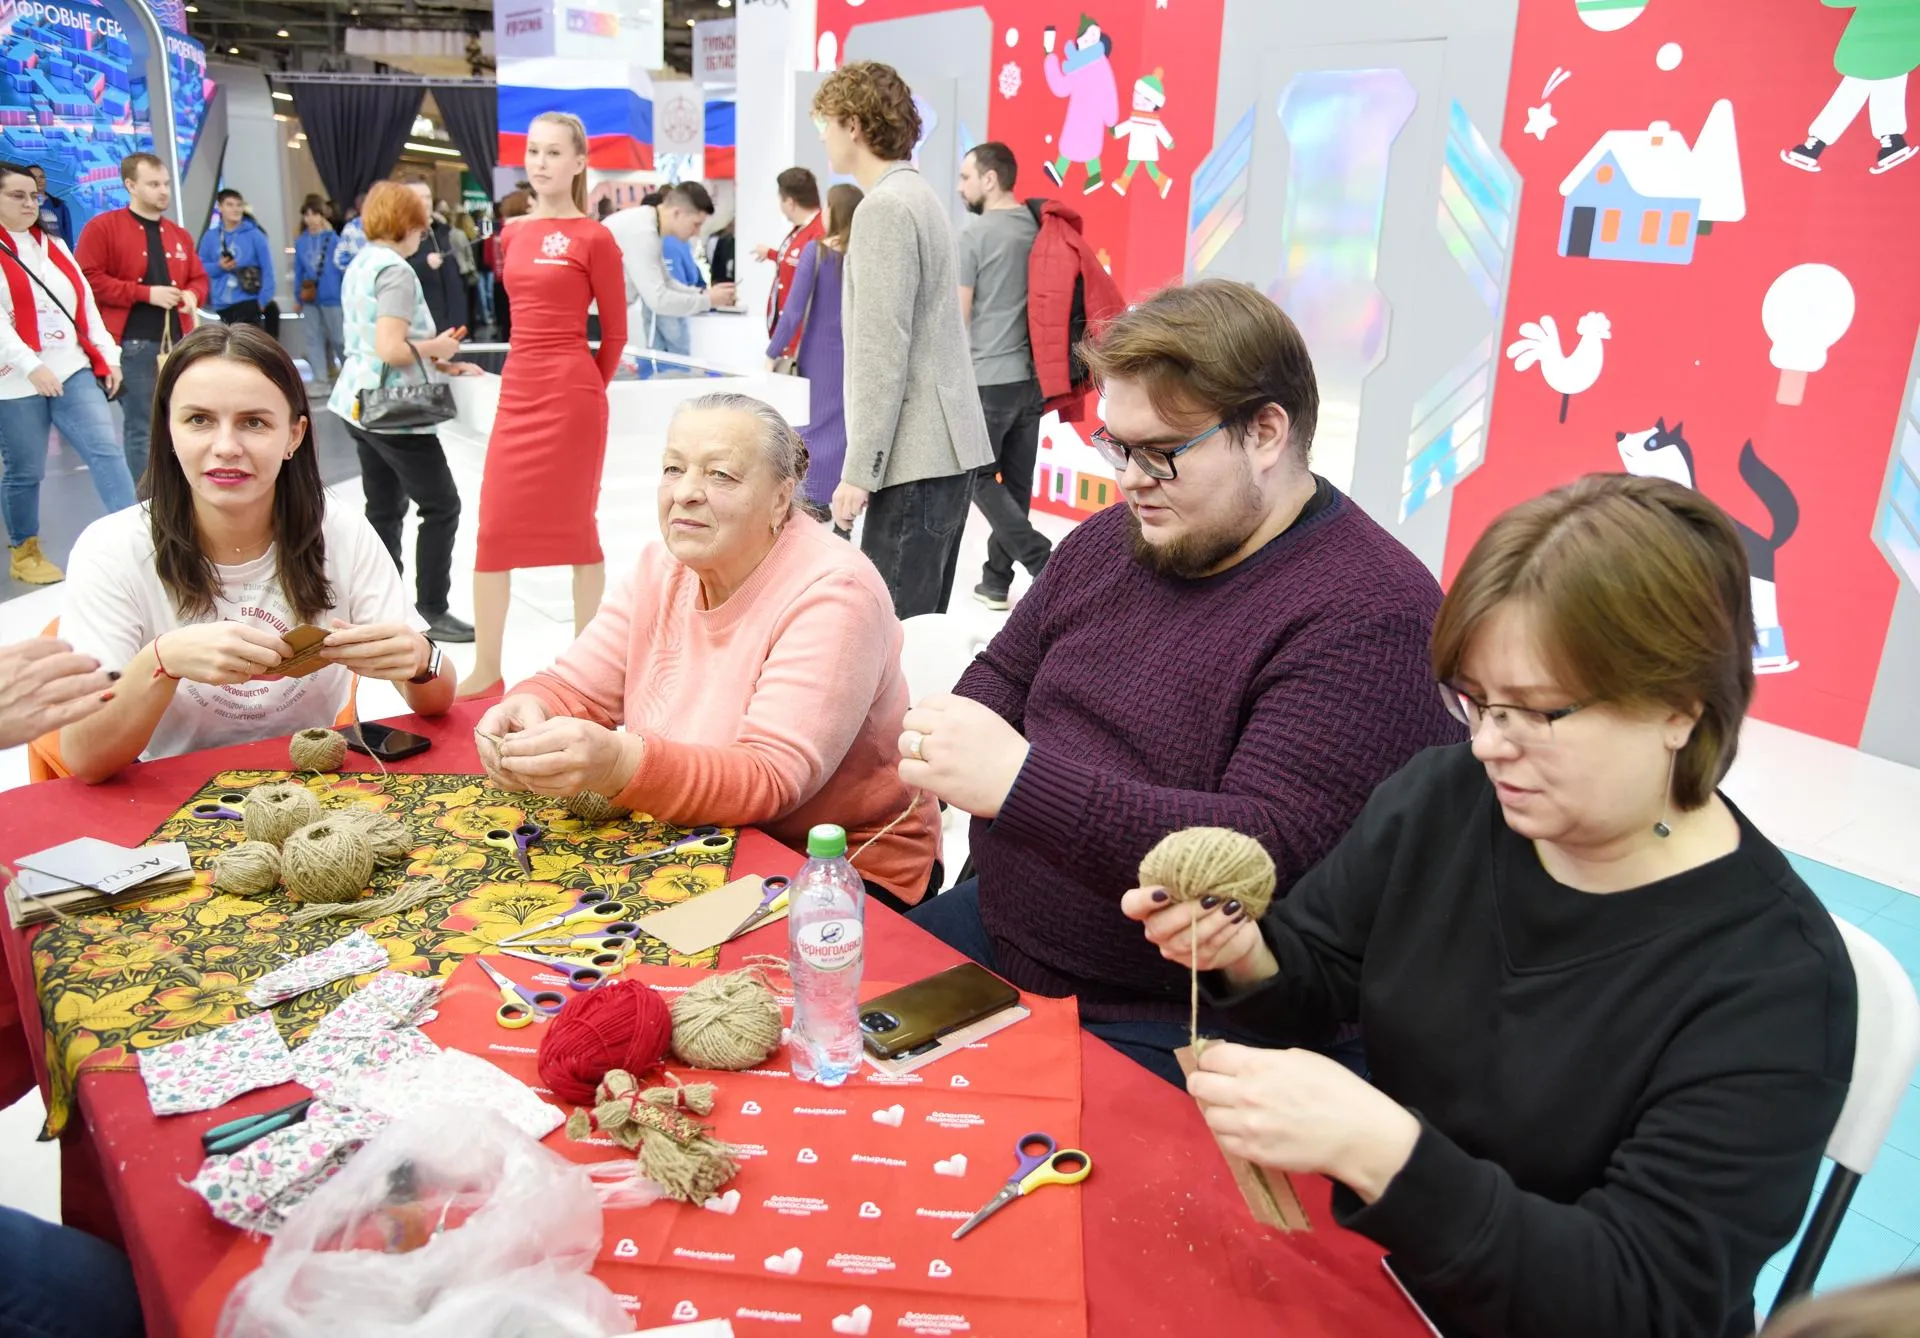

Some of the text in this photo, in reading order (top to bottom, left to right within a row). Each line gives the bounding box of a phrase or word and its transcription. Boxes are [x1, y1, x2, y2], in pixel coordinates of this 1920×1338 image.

[0, 0, 128, 40] ИФРОВЫЕ СЕР
[241, 606, 290, 634] ВЕЛОПУШК
